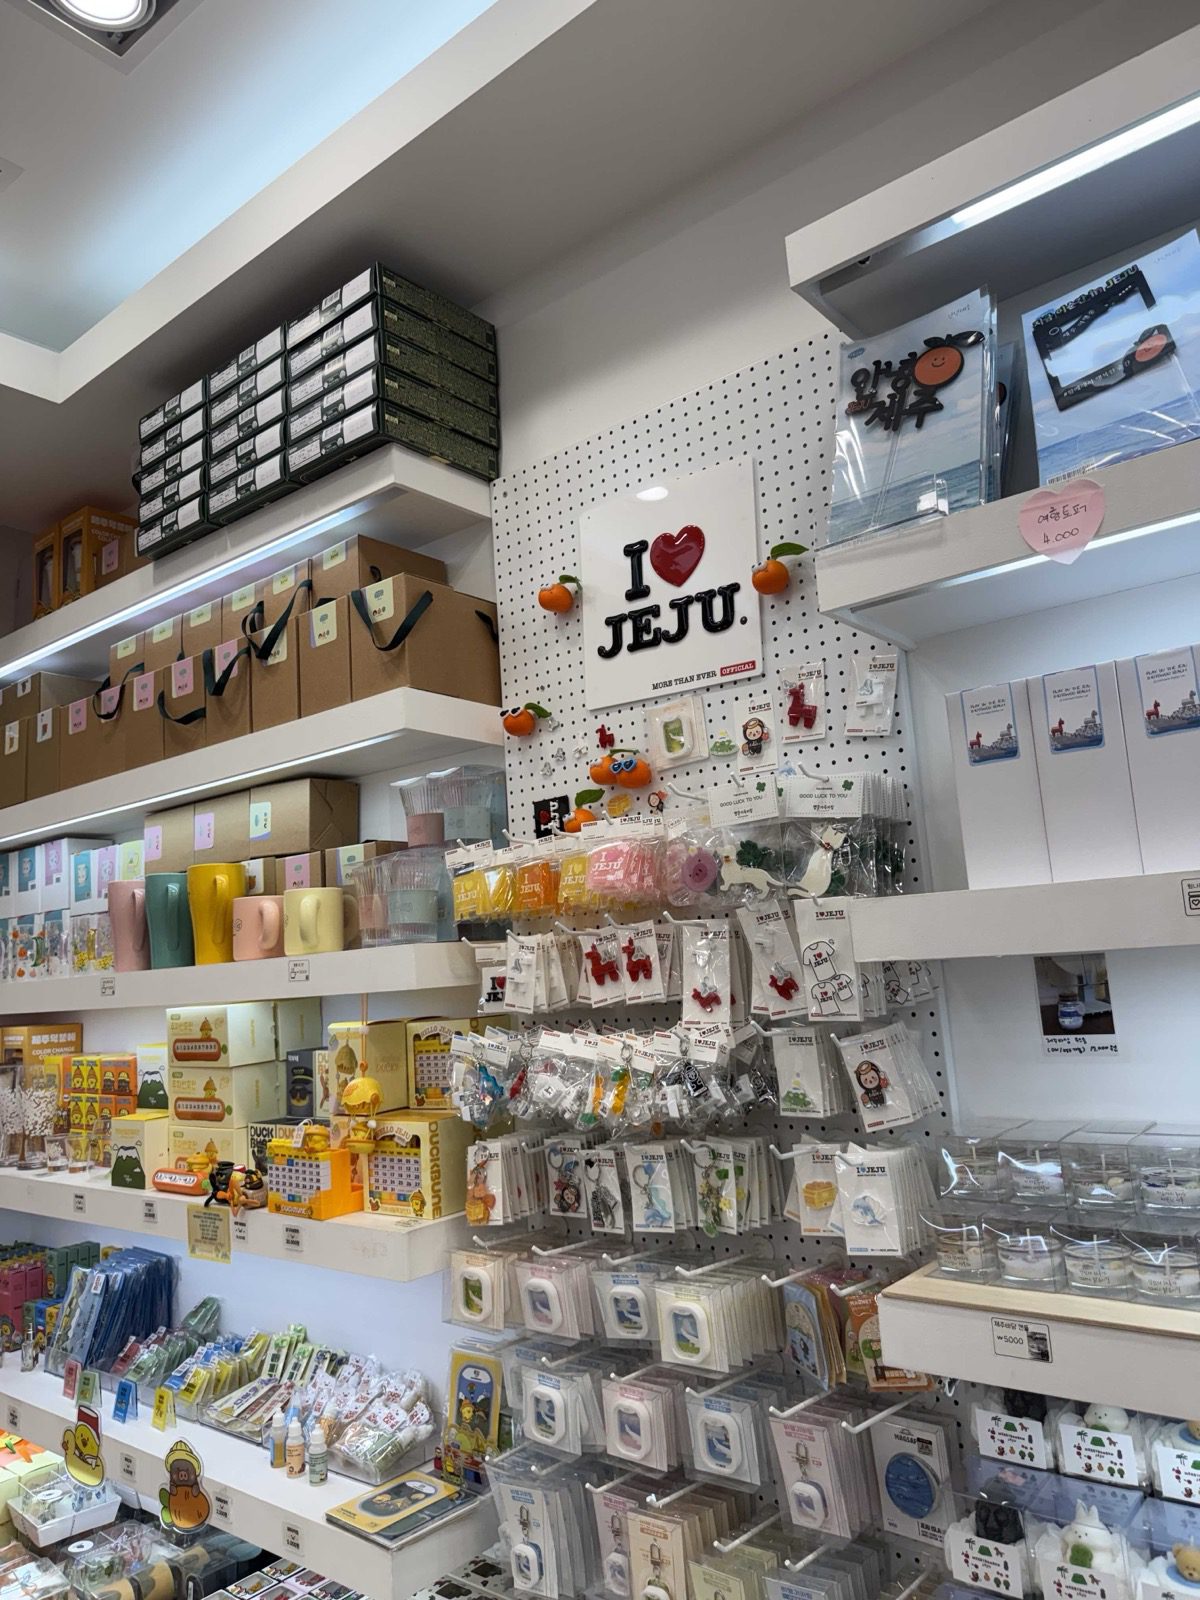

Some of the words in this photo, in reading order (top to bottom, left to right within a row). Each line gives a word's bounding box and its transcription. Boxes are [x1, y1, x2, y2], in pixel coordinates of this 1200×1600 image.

[623, 539, 651, 602] I
[651, 680, 673, 691] MORE
[673, 676, 695, 686] THAN
[696, 670, 718, 681] EVER
[721, 662, 754, 675] OFFICIAL
[599, 851, 608, 862] I
[592, 861, 621, 872] JEJU
[562, 875, 586, 885] JEJU
[764, 912, 780, 921] JEJU
[814, 957, 828, 968] JEJU
[489, 976, 498, 990] I
[796, 1036, 813, 1044] JEJU
[868, 1039, 884, 1050] JEJU
[32, 1048, 51, 1056] COLOR
[494, 1044, 507, 1052] JEJU
[641, 1050, 655, 1059] JEJU
[250, 1126, 274, 1138] DUCK
[394, 1127, 412, 1140] JEJU
[866, 1166, 886, 1174] JEJU
